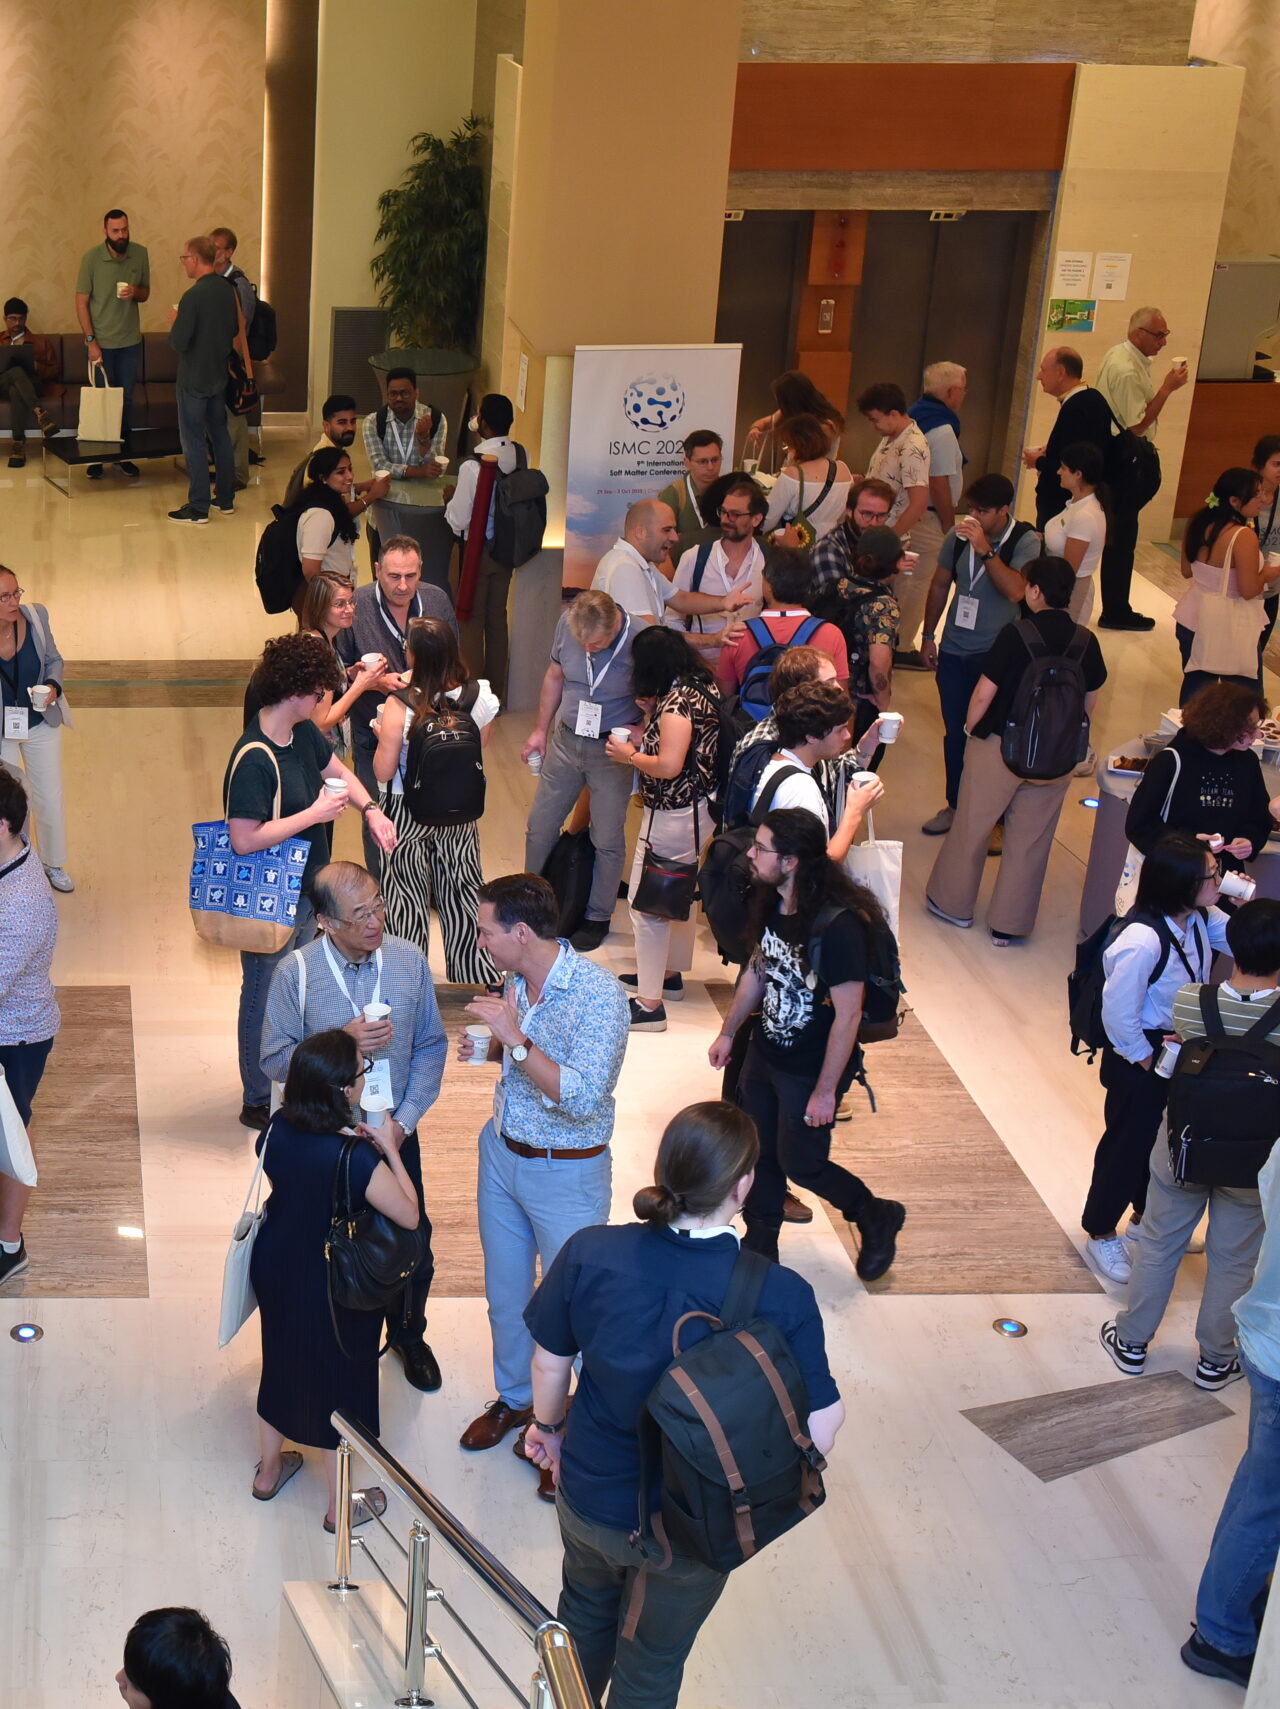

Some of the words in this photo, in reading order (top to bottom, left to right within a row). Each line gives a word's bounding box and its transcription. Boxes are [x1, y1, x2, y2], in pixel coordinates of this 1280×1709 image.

[609, 440, 651, 455] ISMC
[656, 440, 684, 454] 202
[649, 468, 686, 476] Conferenc
